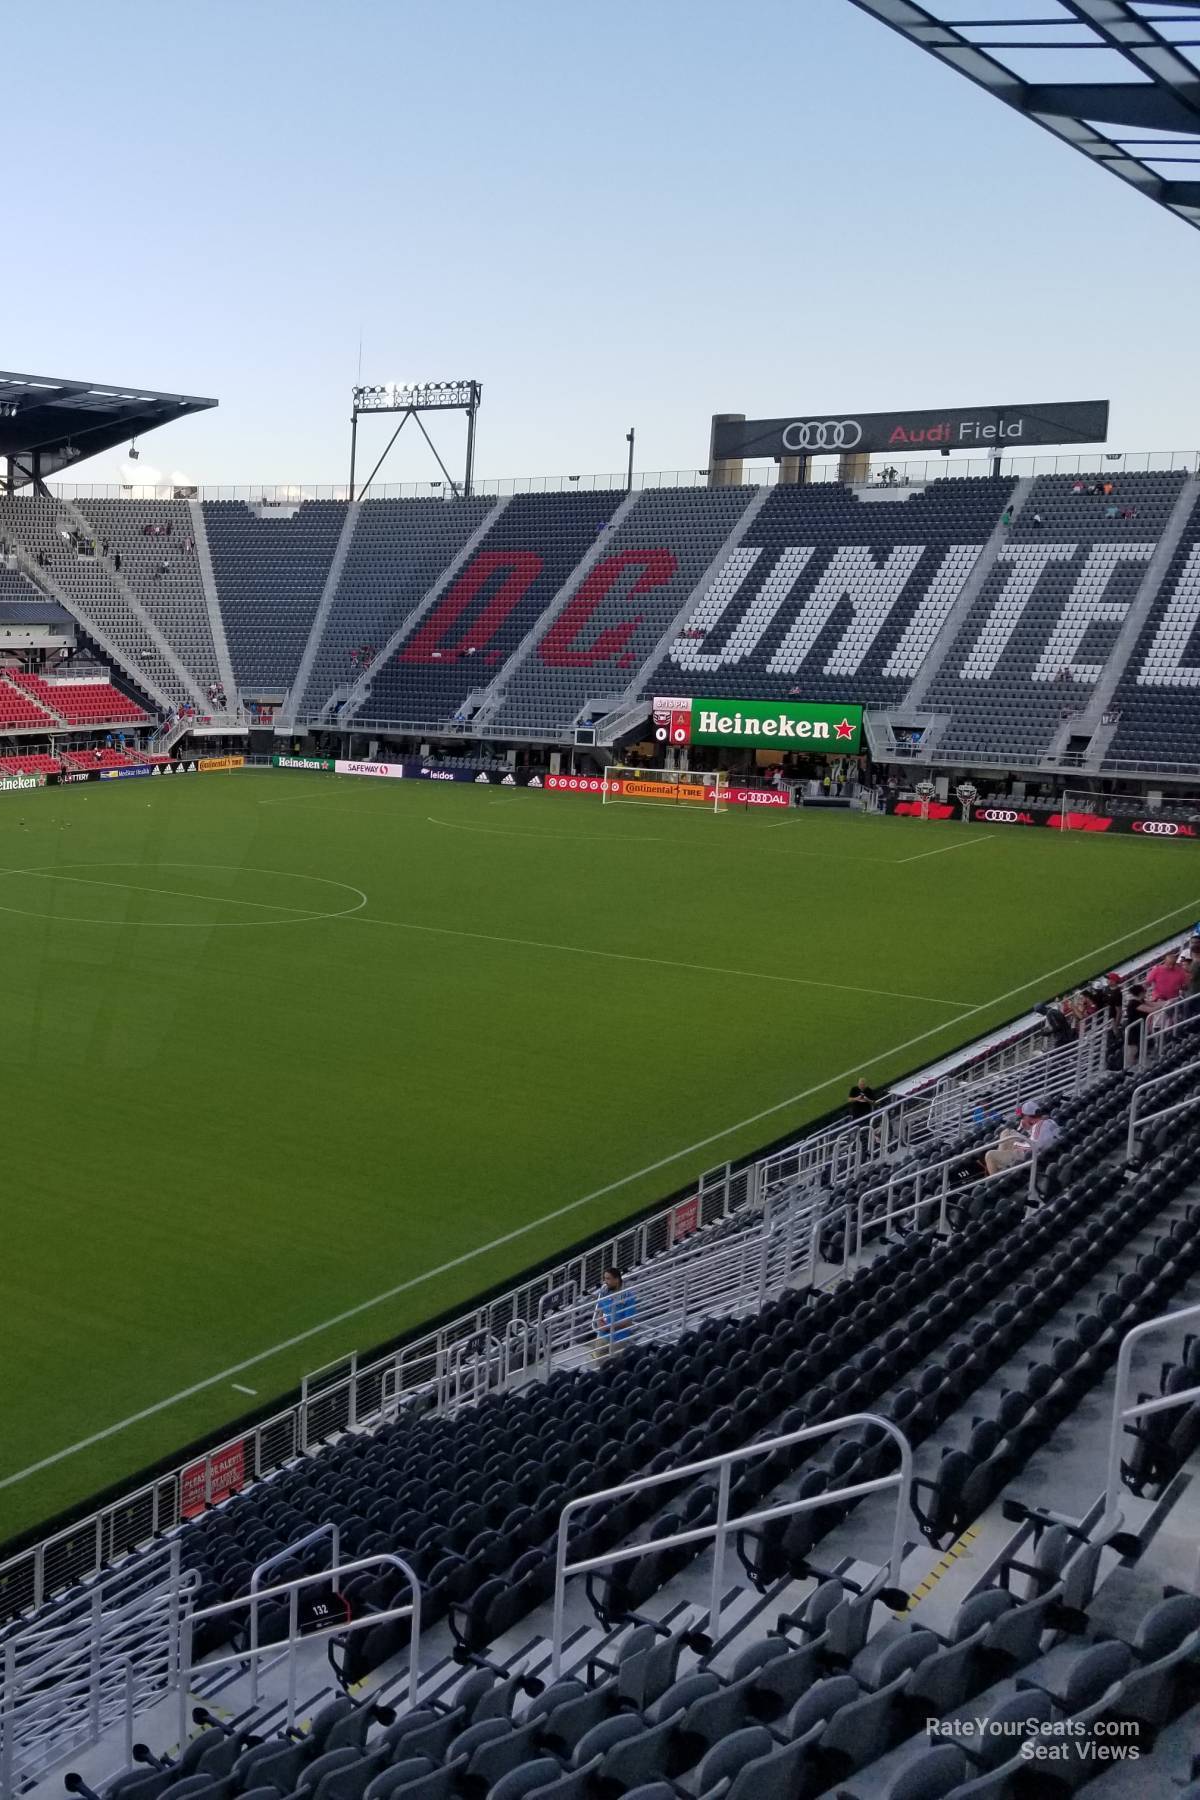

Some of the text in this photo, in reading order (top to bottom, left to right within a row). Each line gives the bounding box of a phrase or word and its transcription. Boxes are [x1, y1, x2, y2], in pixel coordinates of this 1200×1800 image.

[889, 419, 1023, 443] Audi Field
[699, 712, 830, 738] Heineken
[656, 728, 686, 741] 0 0
[279, 757, 320, 769] Heineken
[347, 763, 378, 773] SAFEWAY
[430, 771, 454, 780] leidos
[625, 783, 673, 793] Continental
[709, 790, 731, 799] Audi
[312, 1604, 329, 1616] 132
